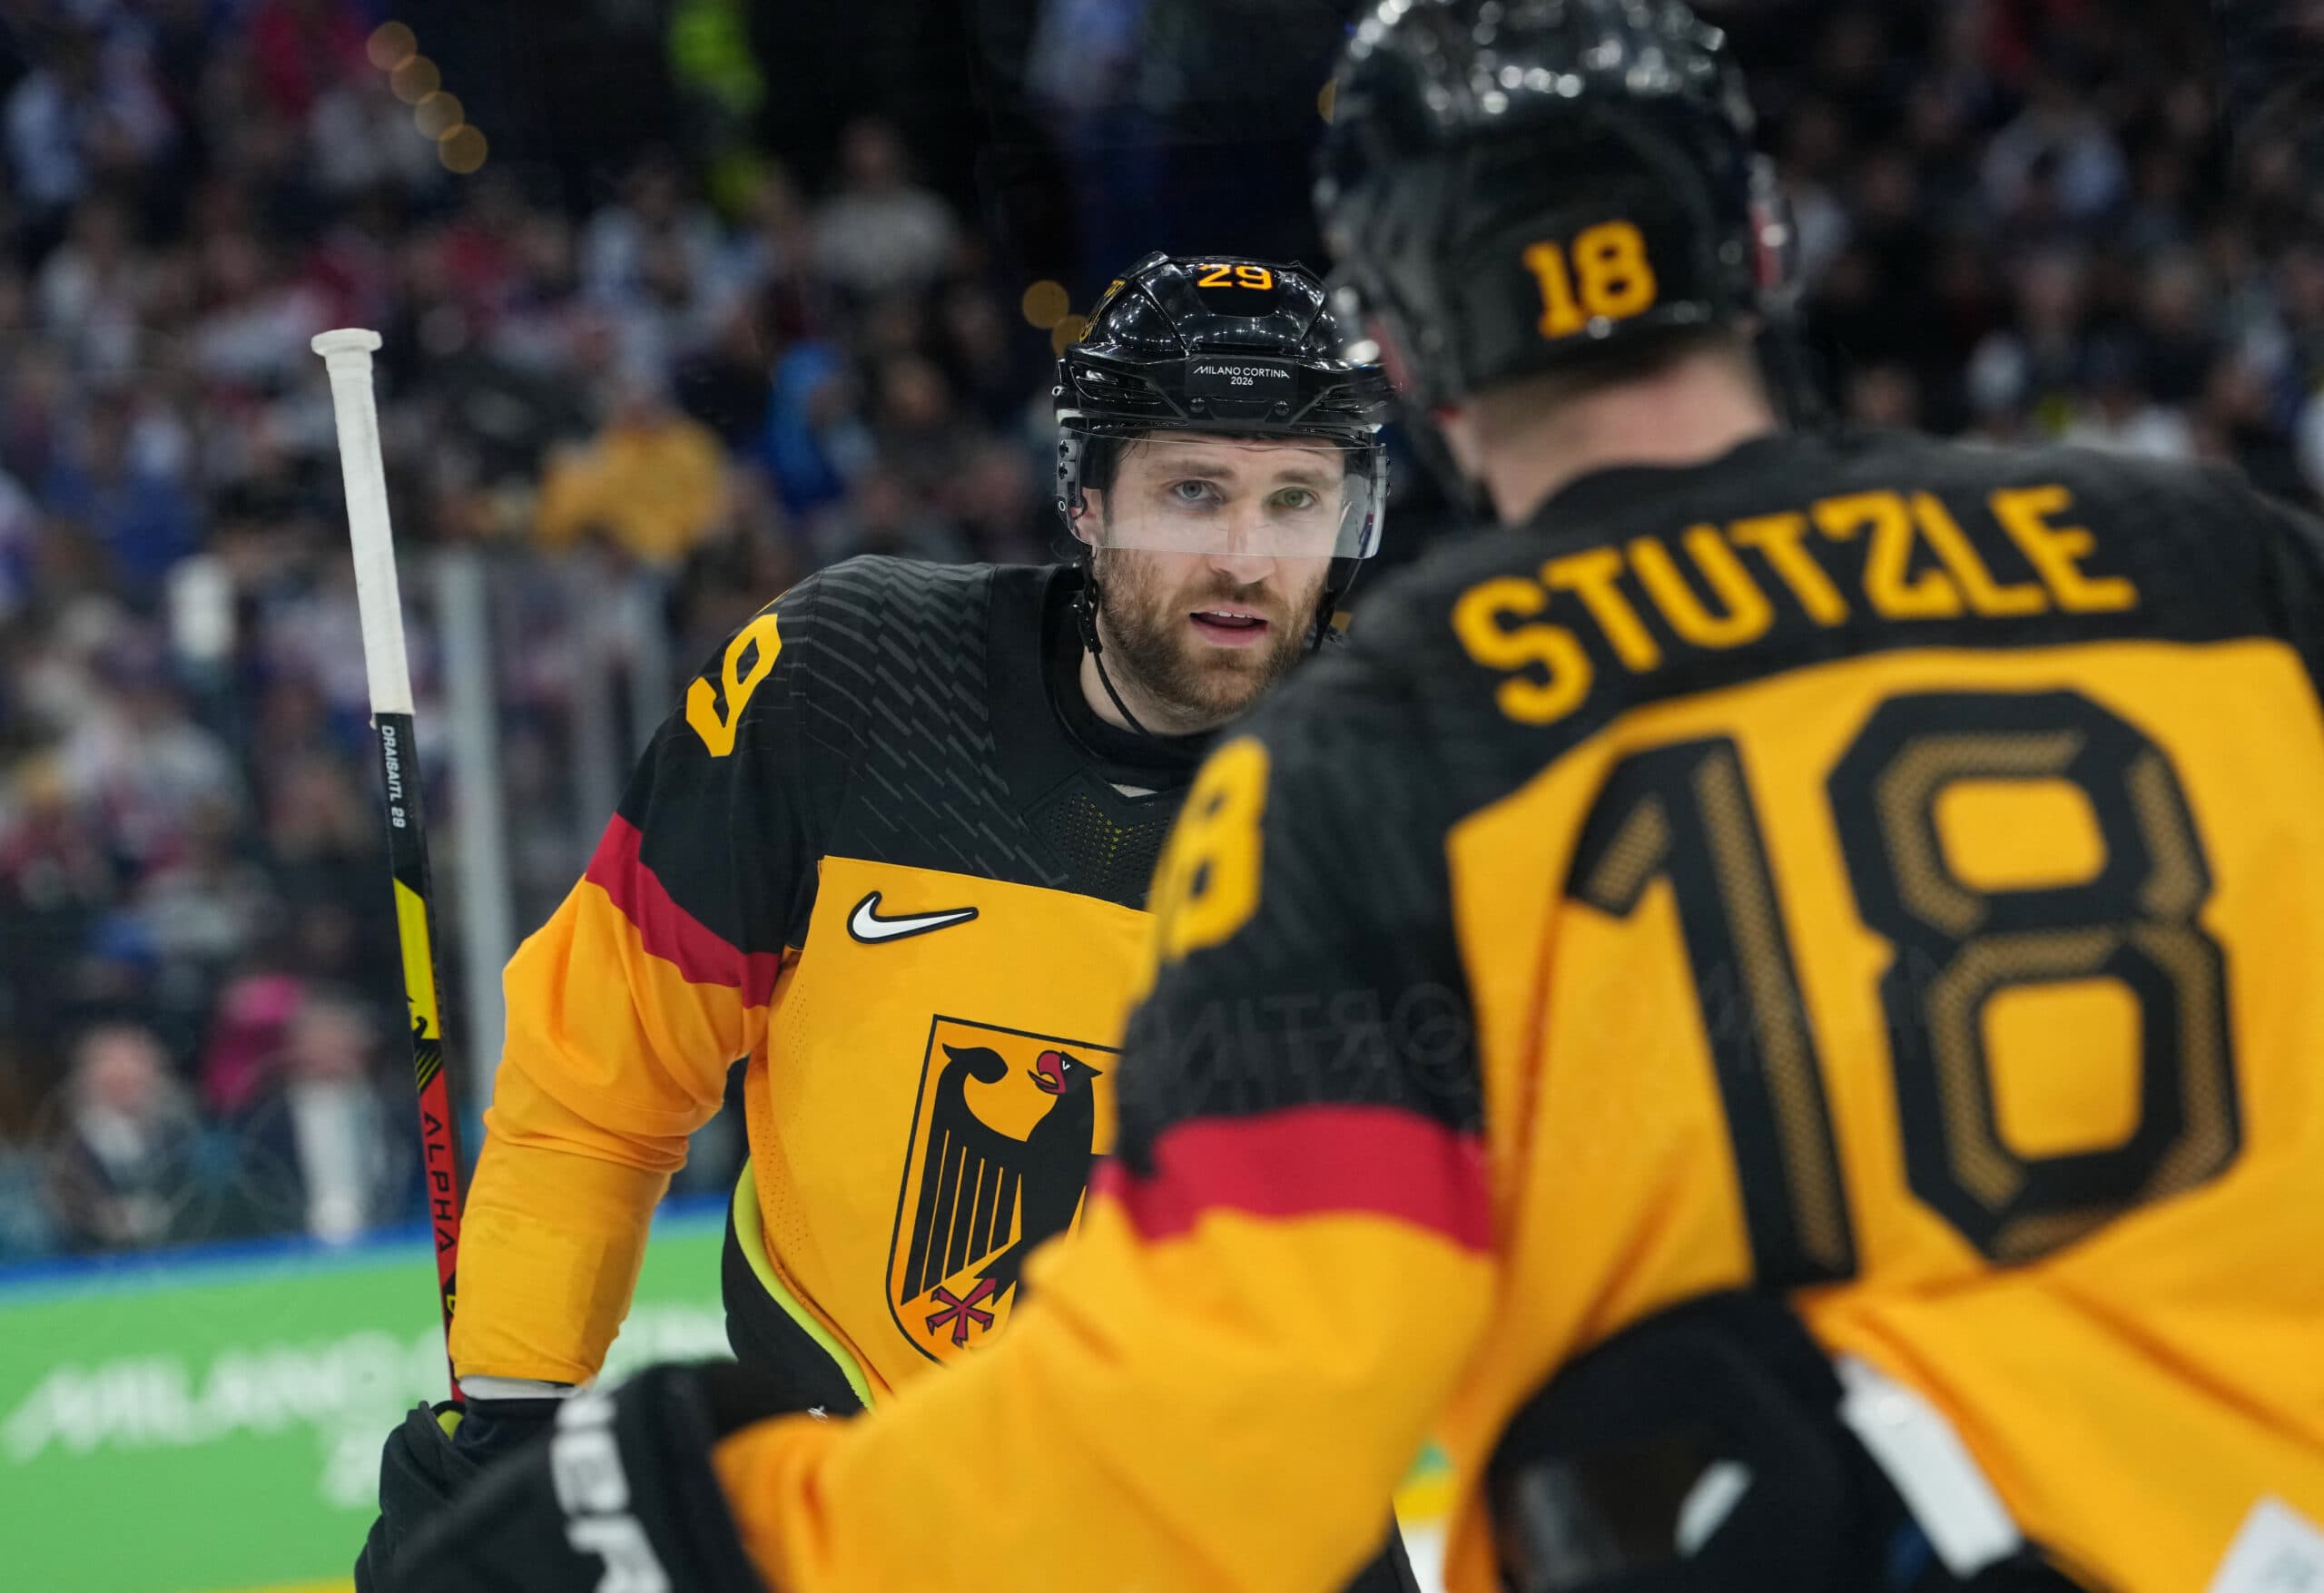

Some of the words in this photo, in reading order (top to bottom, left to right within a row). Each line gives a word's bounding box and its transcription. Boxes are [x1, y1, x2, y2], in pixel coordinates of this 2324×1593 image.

[1197, 264, 1273, 290] 29
[1523, 221, 1657, 339] 18
[1194, 366, 1241, 376] MILANO
[1243, 367, 1290, 379] CORTINA
[1231, 377, 1254, 385] 2026
[1451, 483, 2139, 725] STUTZLE
[686, 609, 783, 757] 9
[381, 725, 402, 801] DRAISAITL
[391, 807, 407, 828] 29
[1151, 737, 1270, 963] 8
[1562, 683, 2245, 1283] 18
[424, 1113, 456, 1253] ALPHA
